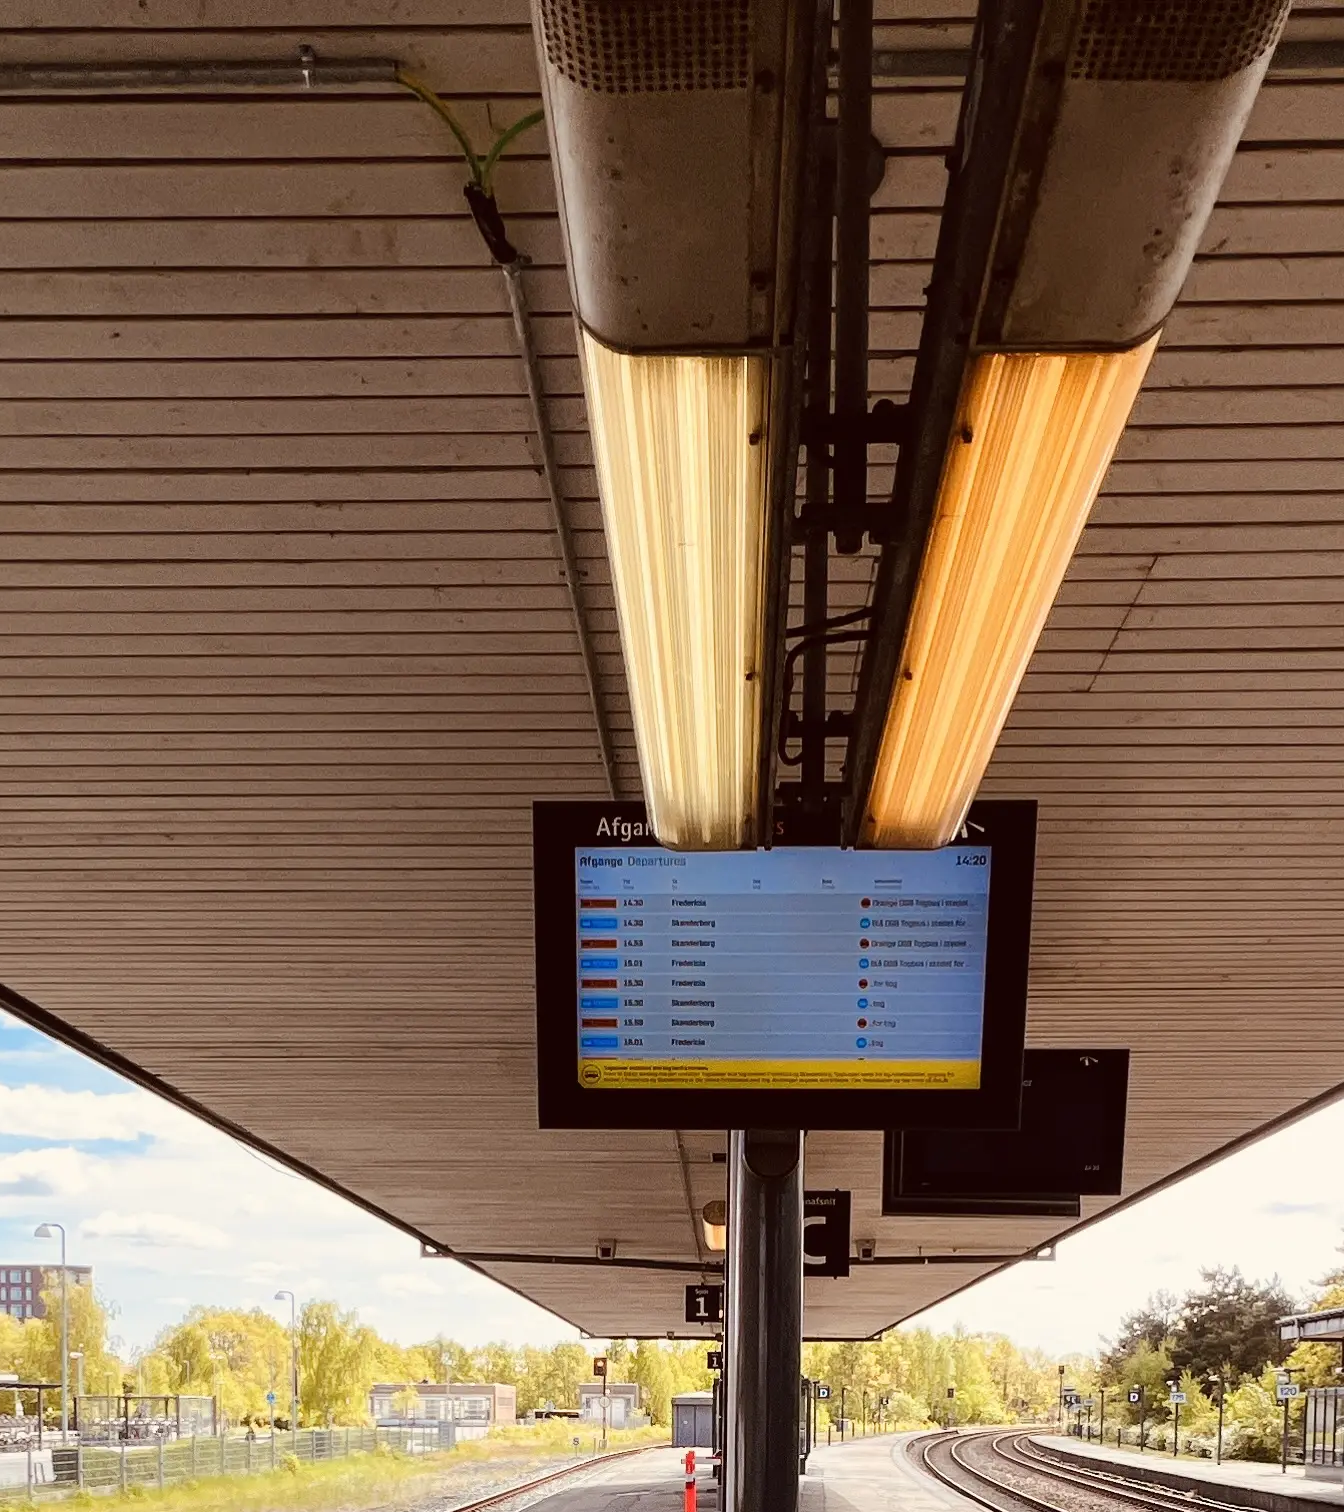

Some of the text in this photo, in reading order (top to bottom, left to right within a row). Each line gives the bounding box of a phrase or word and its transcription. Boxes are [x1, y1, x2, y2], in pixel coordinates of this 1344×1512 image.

[627, 856, 686, 867] Departures
[956, 855, 986, 866] 14:20
[695, 1297, 709, 1317] 1
[712, 1357, 719, 1367] 1
[820, 1388, 828, 1398] D
[1280, 1387, 1297, 1396] 120
[1129, 1392, 1139, 1402] D
